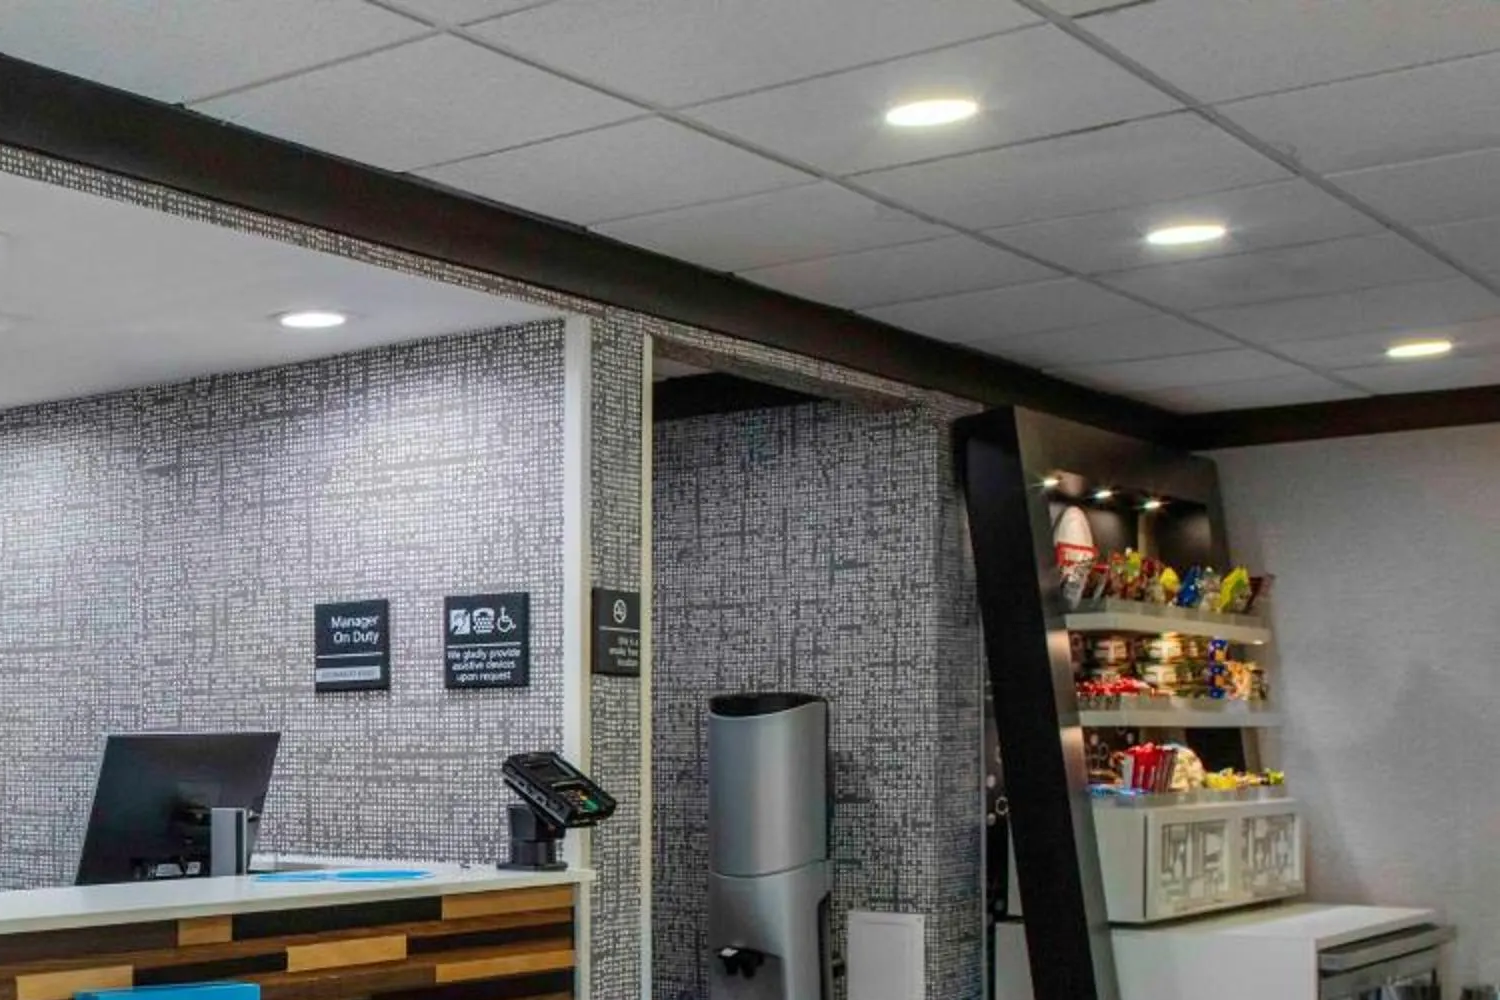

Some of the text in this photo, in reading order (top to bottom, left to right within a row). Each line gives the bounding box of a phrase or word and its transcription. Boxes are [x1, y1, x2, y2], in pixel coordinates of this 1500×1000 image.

[331, 615, 379, 630] Manager
[333, 630, 380, 645] On Duty
[489, 647, 521, 662] provide
